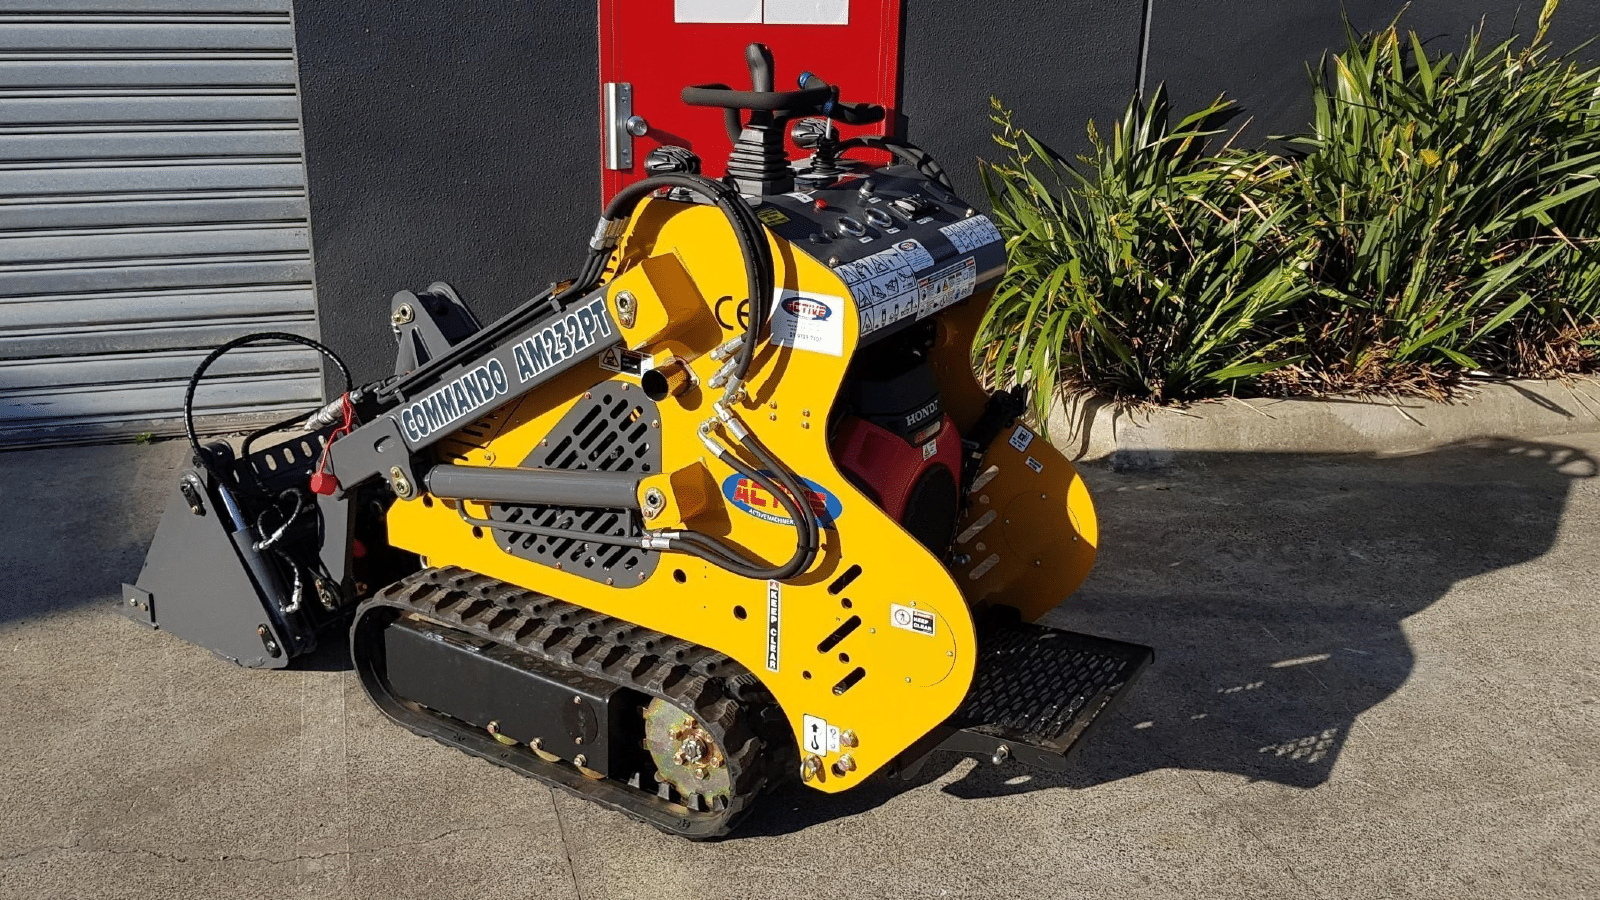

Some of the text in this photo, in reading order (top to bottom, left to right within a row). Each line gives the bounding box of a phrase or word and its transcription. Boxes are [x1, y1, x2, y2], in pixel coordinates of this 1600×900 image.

[402, 297, 611, 441] COMMANDO AM232PT
[748, 508, 796, 526] ACTIVEMACHINER
[769, 590, 778, 669] KEEP CLEAR
[913, 623, 932, 631] CLEAR
